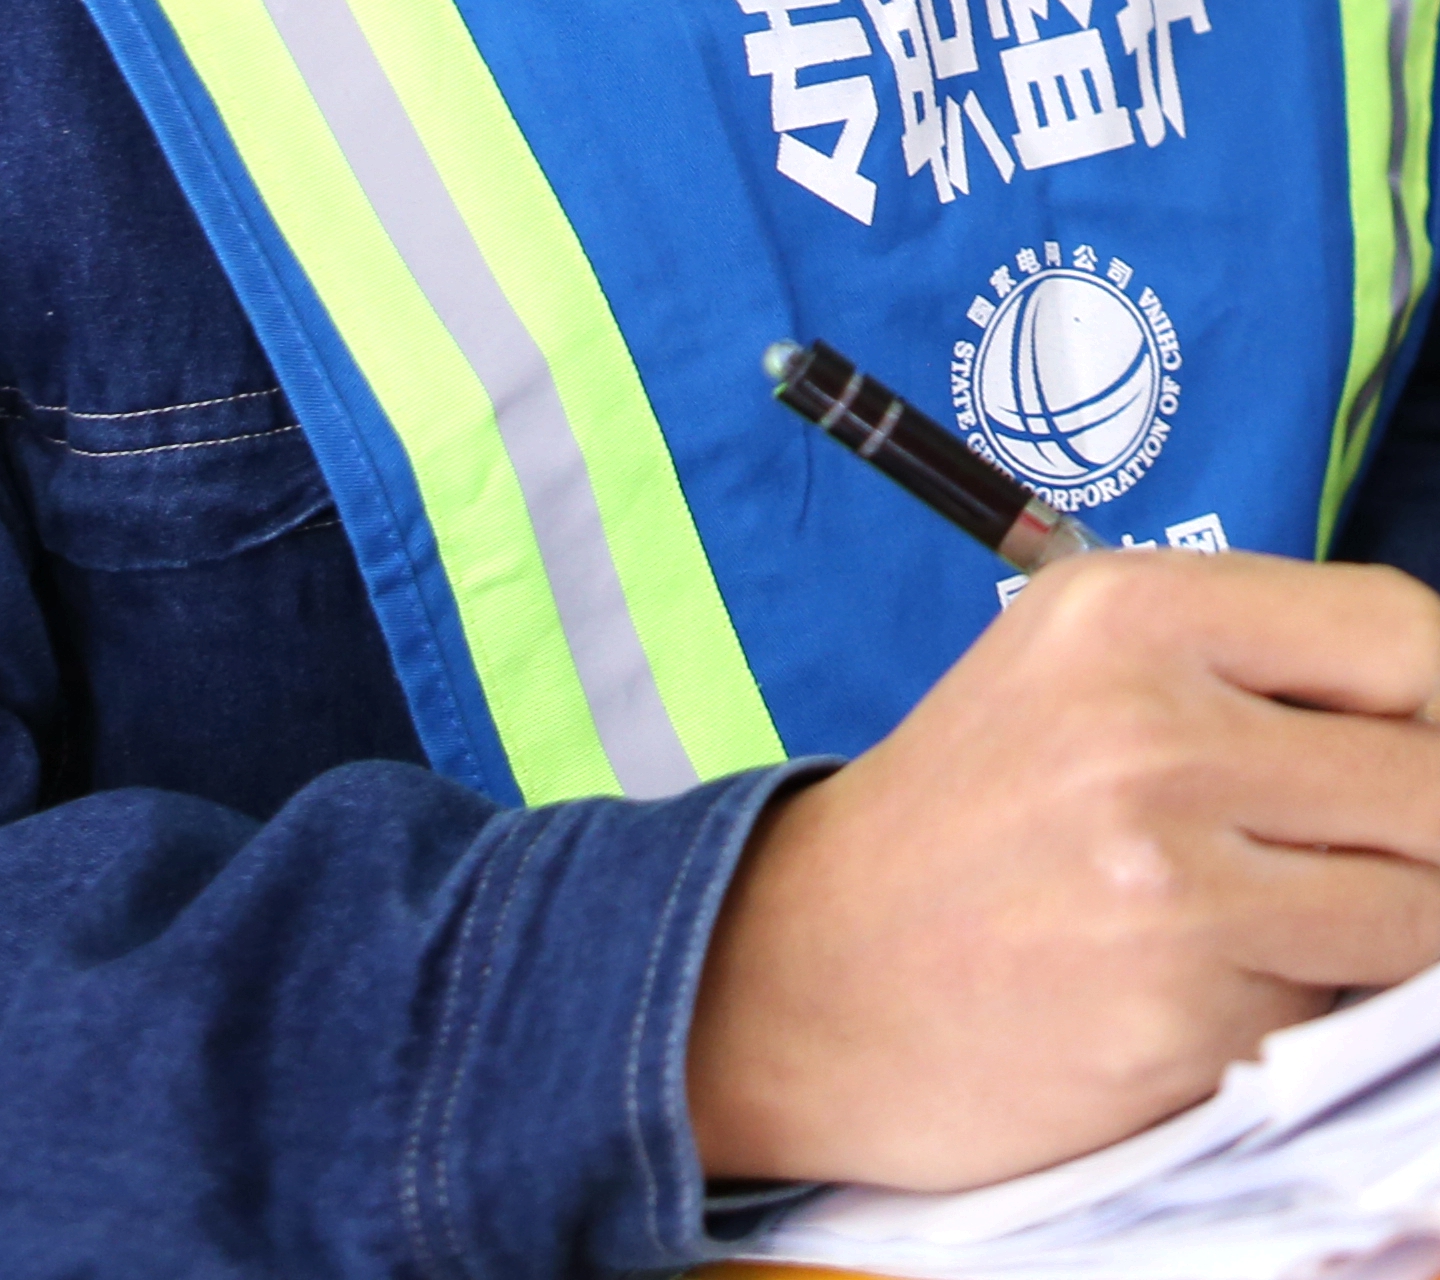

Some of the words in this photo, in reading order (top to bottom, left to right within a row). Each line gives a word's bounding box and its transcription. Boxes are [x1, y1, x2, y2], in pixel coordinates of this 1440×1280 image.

[1138, 286, 1183, 372] CHINA
[951, 338, 977, 430] STATE
[1159, 375, 1182, 416] OF
